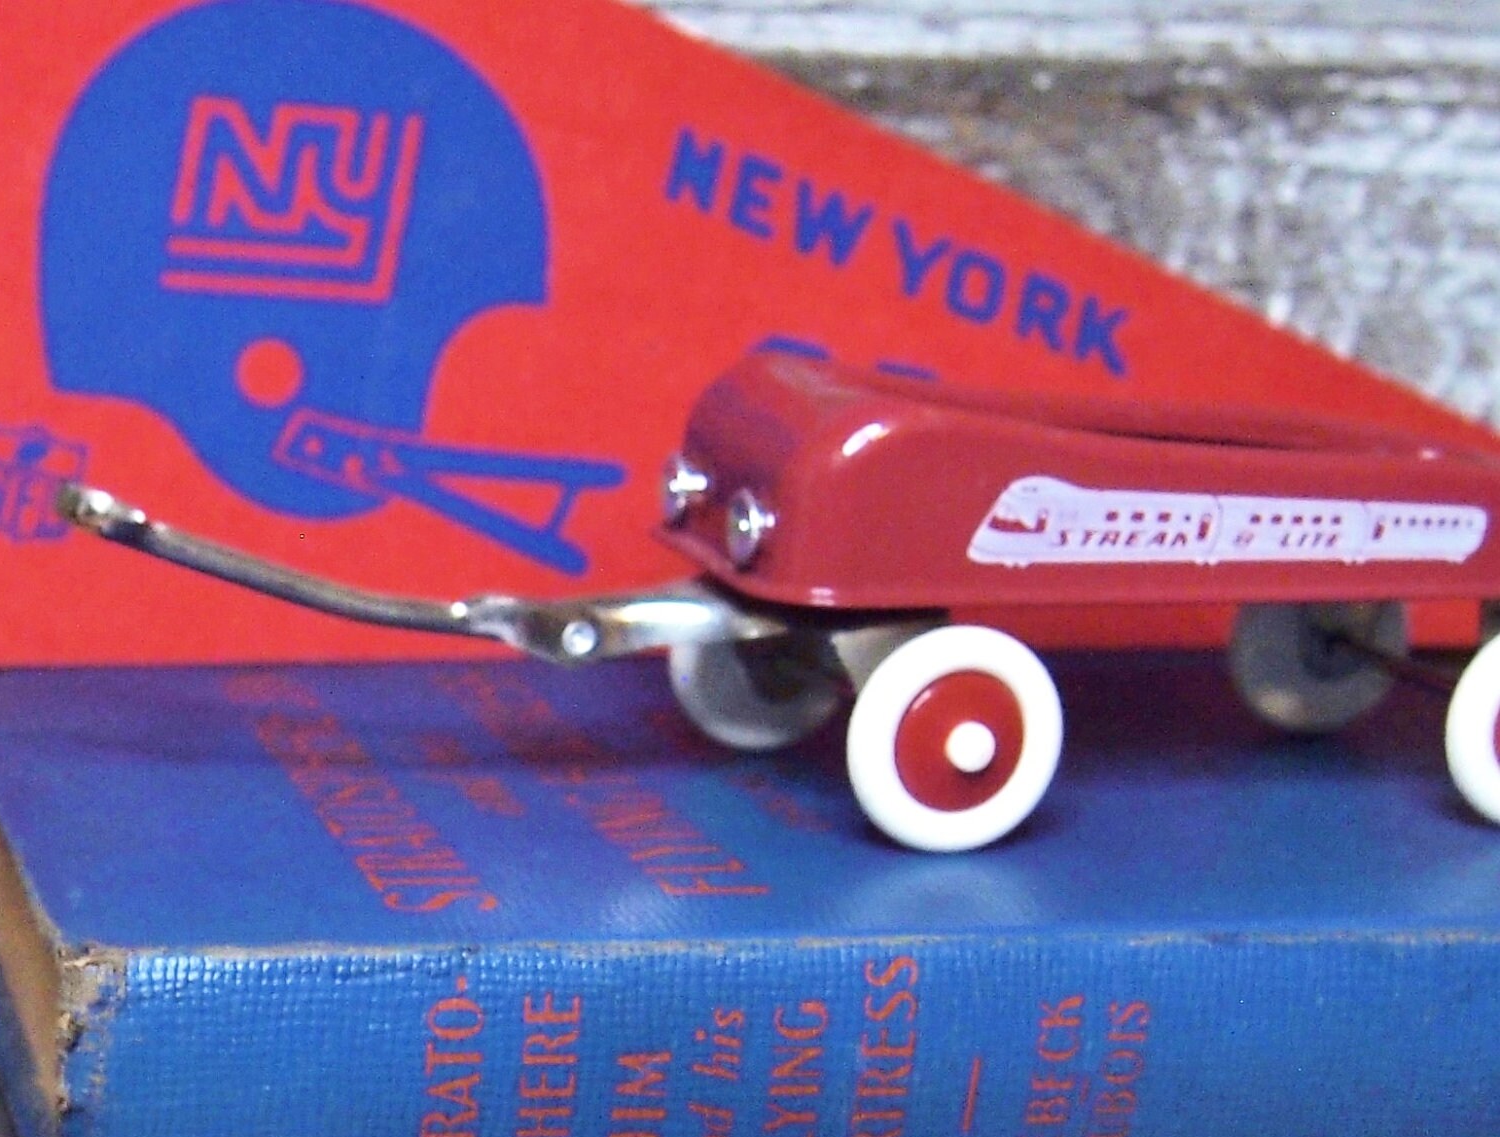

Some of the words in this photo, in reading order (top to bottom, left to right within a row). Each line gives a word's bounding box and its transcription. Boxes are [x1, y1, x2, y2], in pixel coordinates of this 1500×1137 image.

[665, 127, 873, 268] NEW
[894, 217, 1128, 377] YORK
[692, 1005, 746, 1081] his
